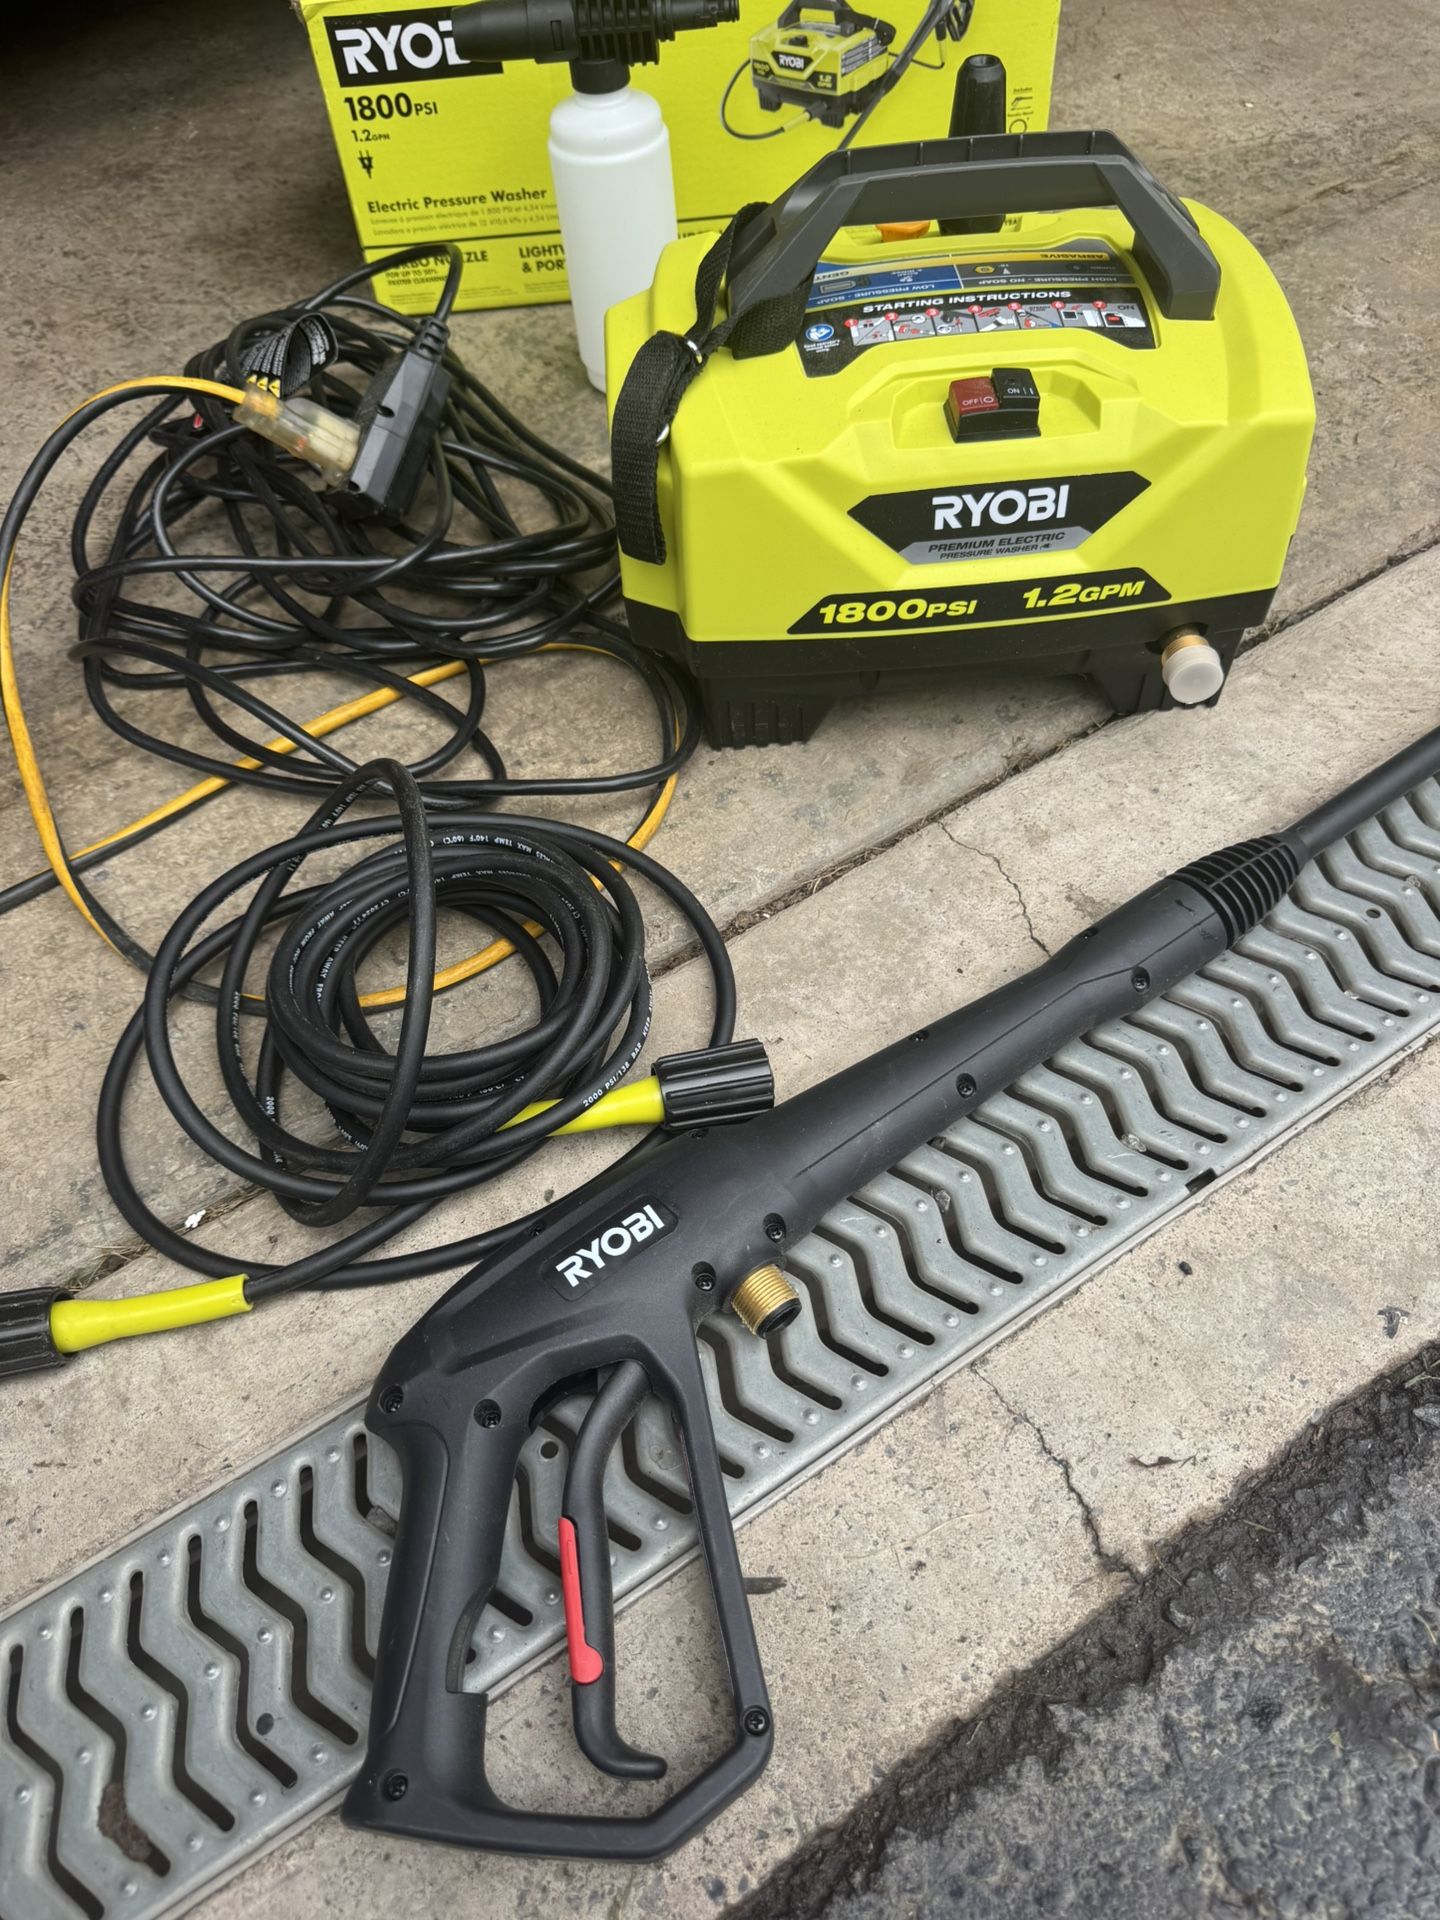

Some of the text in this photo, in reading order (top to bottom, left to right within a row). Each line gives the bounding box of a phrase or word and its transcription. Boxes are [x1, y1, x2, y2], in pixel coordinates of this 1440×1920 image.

[335, 20, 471, 75] RYO
[778, 54, 805, 70] RYOBI
[367, 187, 547, 213] Electric Pressure Washer
[521, 261, 533, 274] &
[854, 286, 910, 299] PRESSURE
[862, 290, 1072, 313] STARTING INSTRUCTIONS
[962, 398, 979, 406] OFF
[932, 484, 1070, 531] RYOBI
[928, 532, 1066, 553] PREMIUM ELECTRIC
[940, 544, 1038, 560] PRESSURE WASHER
[494, 836, 513, 847] TEMP
[517, 842, 534, 854] MAX
[320, 957, 334, 979] AWAY
[316, 983, 324, 1002] FRO
[582, 1089, 604, 1107] 2000
[604, 1061, 630, 1090] PSI/138
[631, 1042, 643, 1060] BAR
[266, 1096, 275, 1115] 2000
[555, 1204, 665, 1288] RYOBI
